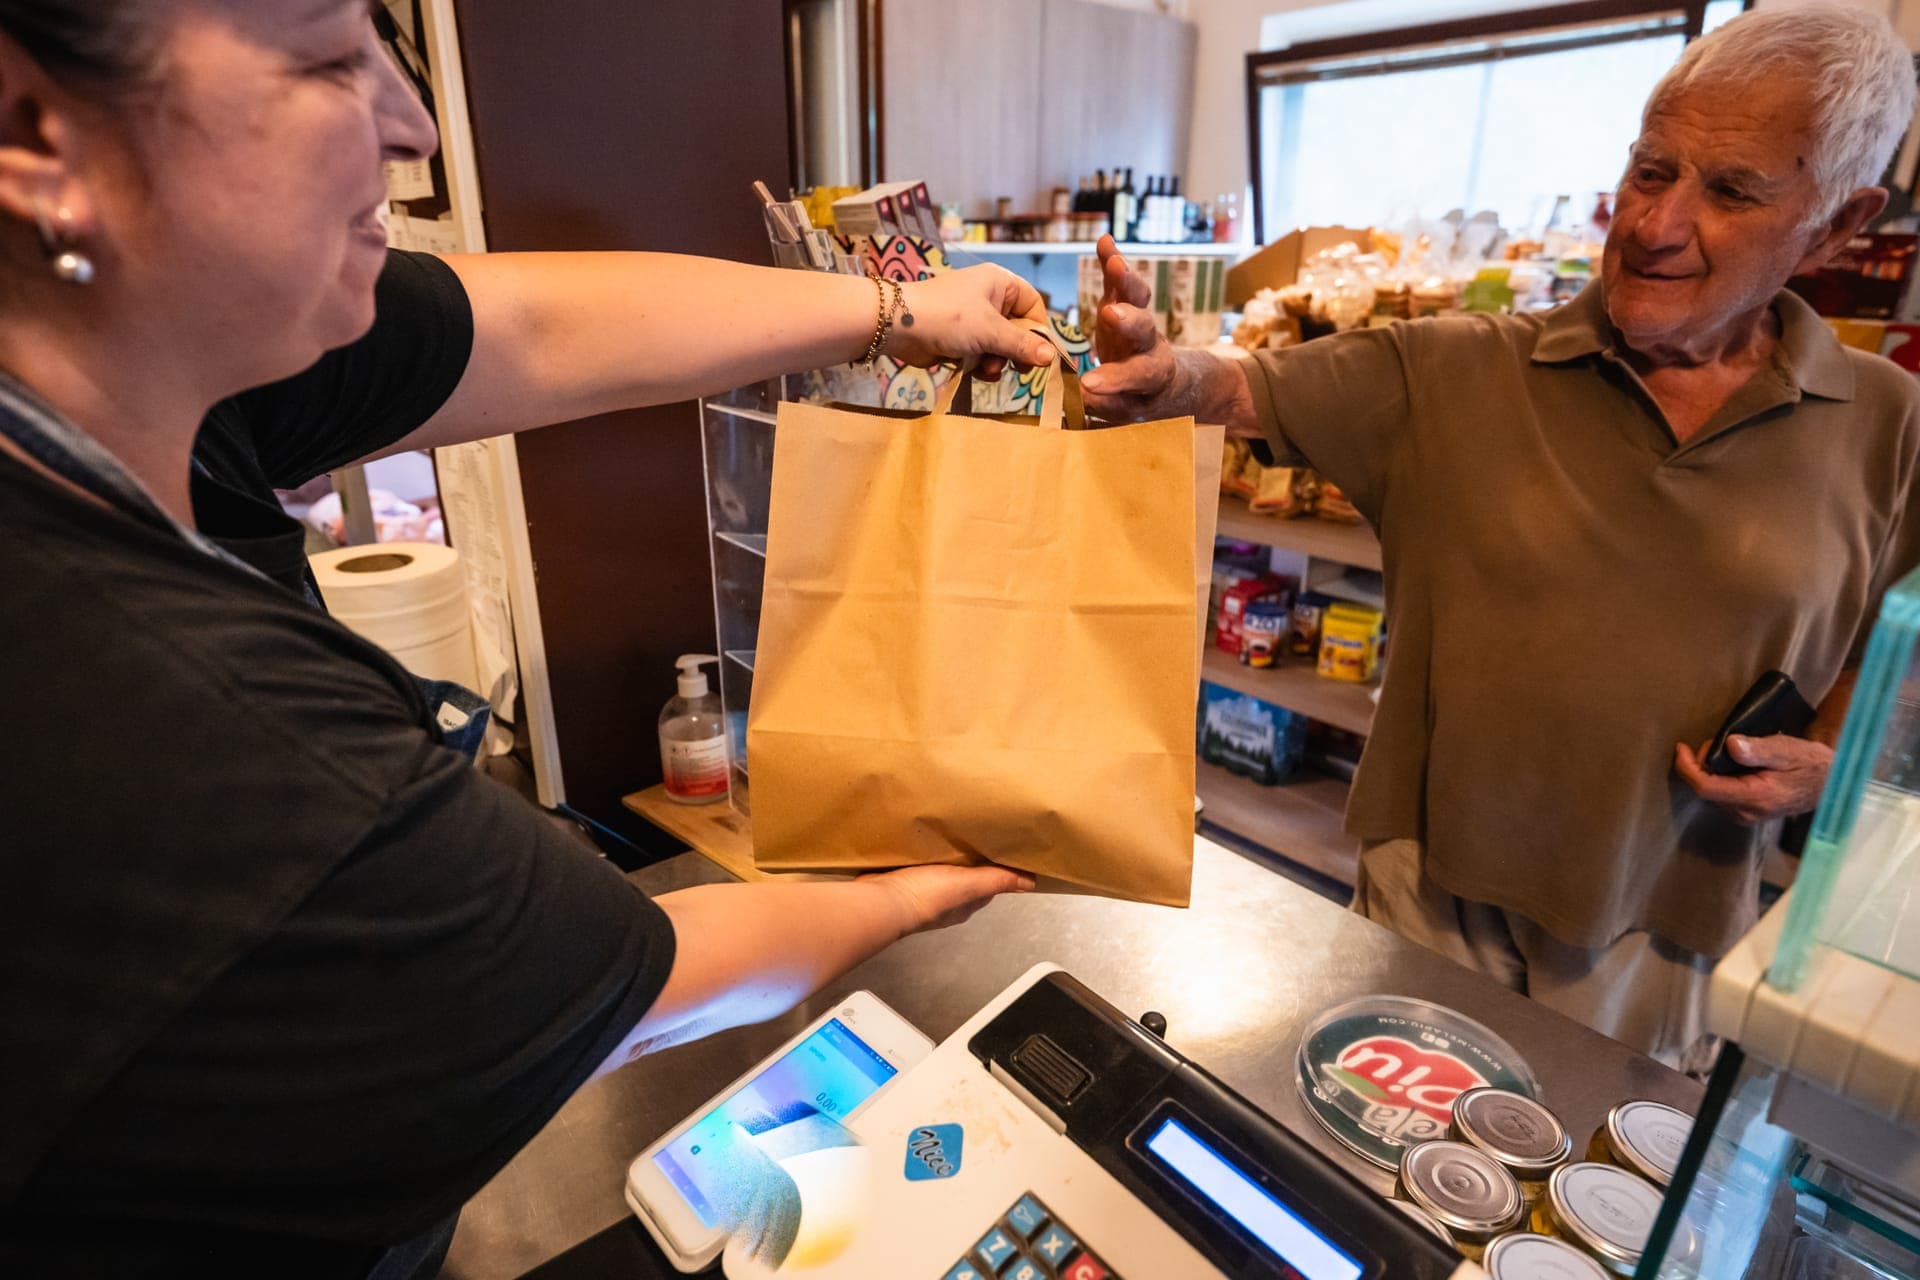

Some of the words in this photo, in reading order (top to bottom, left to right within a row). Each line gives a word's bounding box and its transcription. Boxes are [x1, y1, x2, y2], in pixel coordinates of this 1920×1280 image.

[815, 1092, 838, 1112] 0,00
[1369, 1103, 1446, 1138] ela
[989, 1235, 1008, 1253] 7
[1042, 1233, 1064, 1257] X
